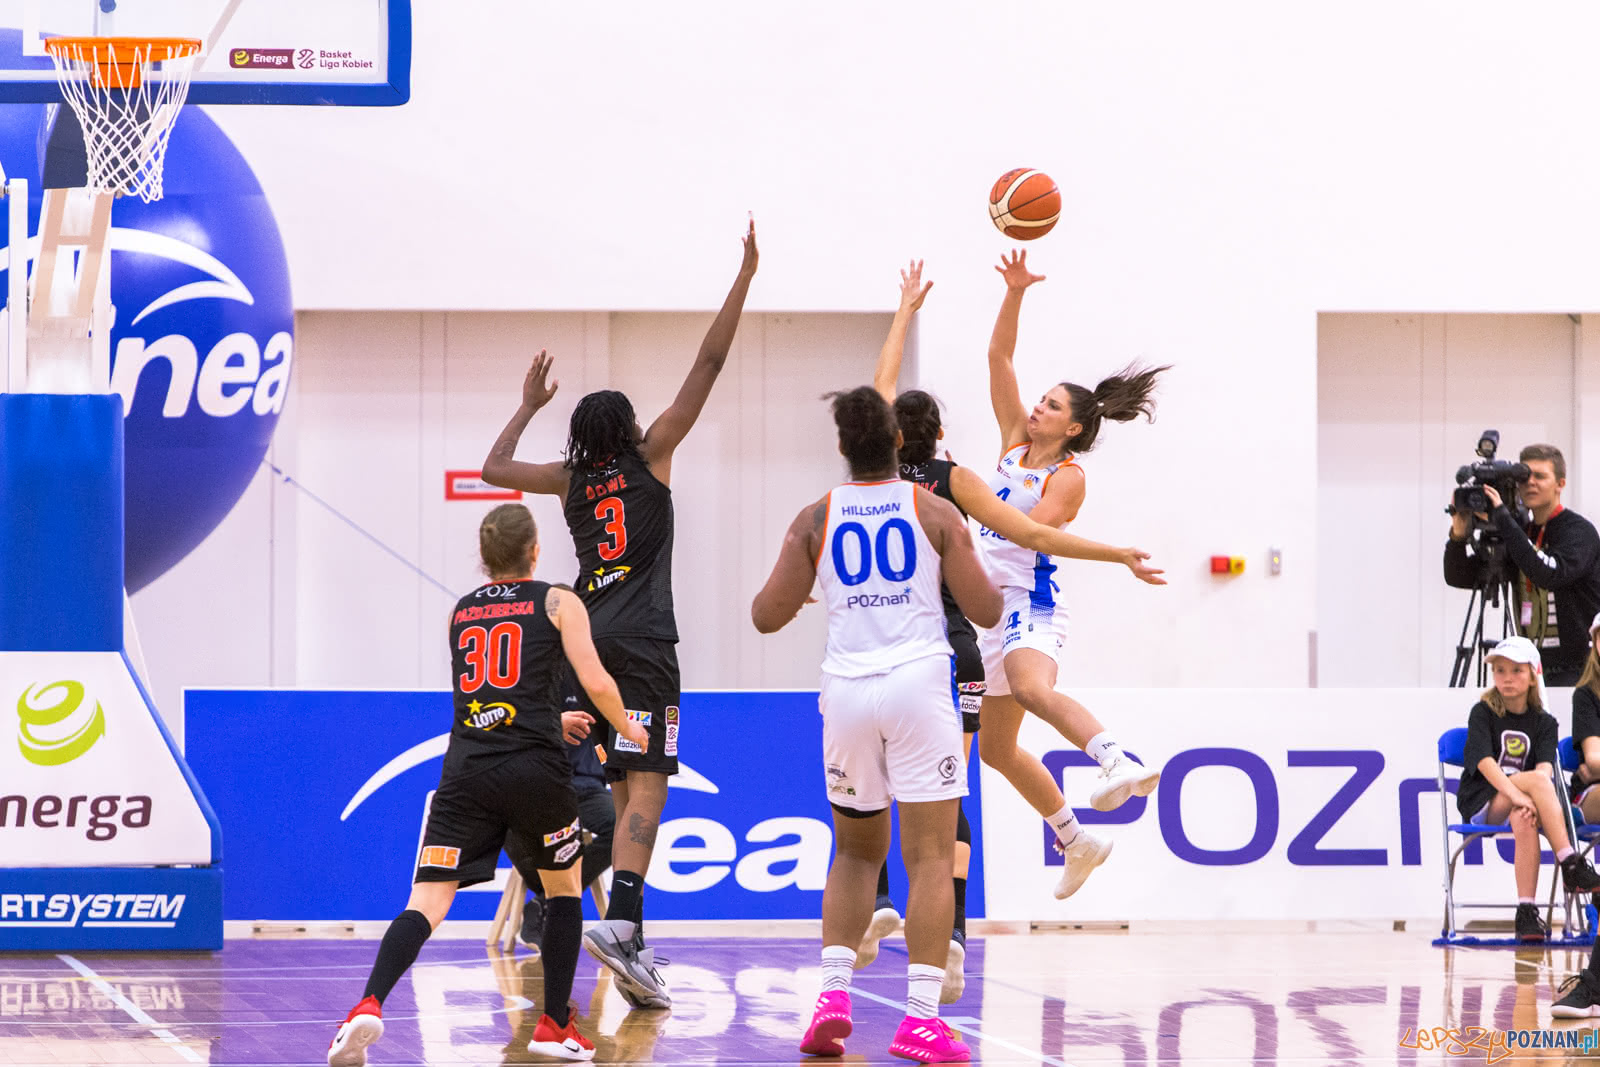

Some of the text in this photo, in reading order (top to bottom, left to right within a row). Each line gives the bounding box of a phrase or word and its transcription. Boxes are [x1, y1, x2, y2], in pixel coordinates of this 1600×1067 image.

[252, 53, 289, 65] Energa
[319, 50, 352, 59] Basket
[319, 60, 373, 70] Liga Kobiet
[110, 332, 292, 419] nea
[841, 502, 902, 517] HILLSMAN
[594, 496, 628, 561] 3
[831, 517, 918, 587] 00
[1004, 611, 1022, 631] 4
[458, 621, 523, 694] 30
[473, 707, 506, 729] LOTTO
[0, 795, 152, 841] nerga
